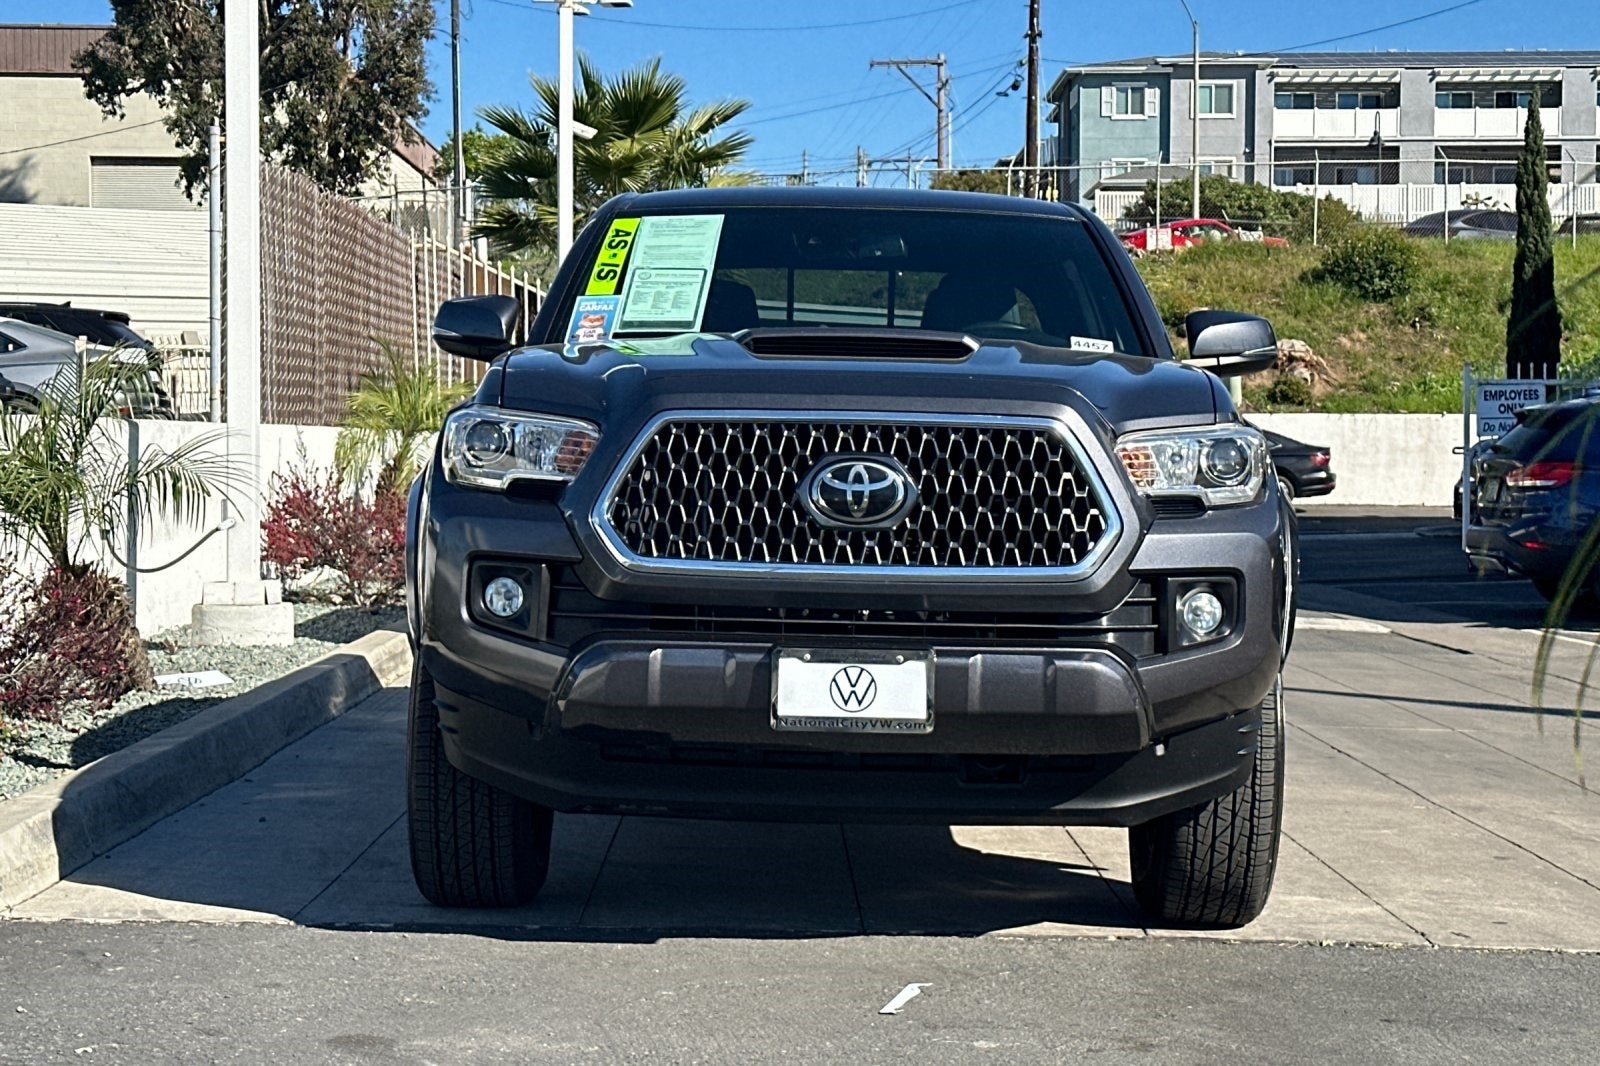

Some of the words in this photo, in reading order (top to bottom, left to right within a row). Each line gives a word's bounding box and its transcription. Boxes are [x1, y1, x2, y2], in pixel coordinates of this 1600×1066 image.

[1074, 341, 1109, 351] 4457
[1483, 389, 1540, 401] EMPLOYEES
[1483, 422, 1495, 432] Do
[778, 717, 926, 730] NationalCityVW.com
